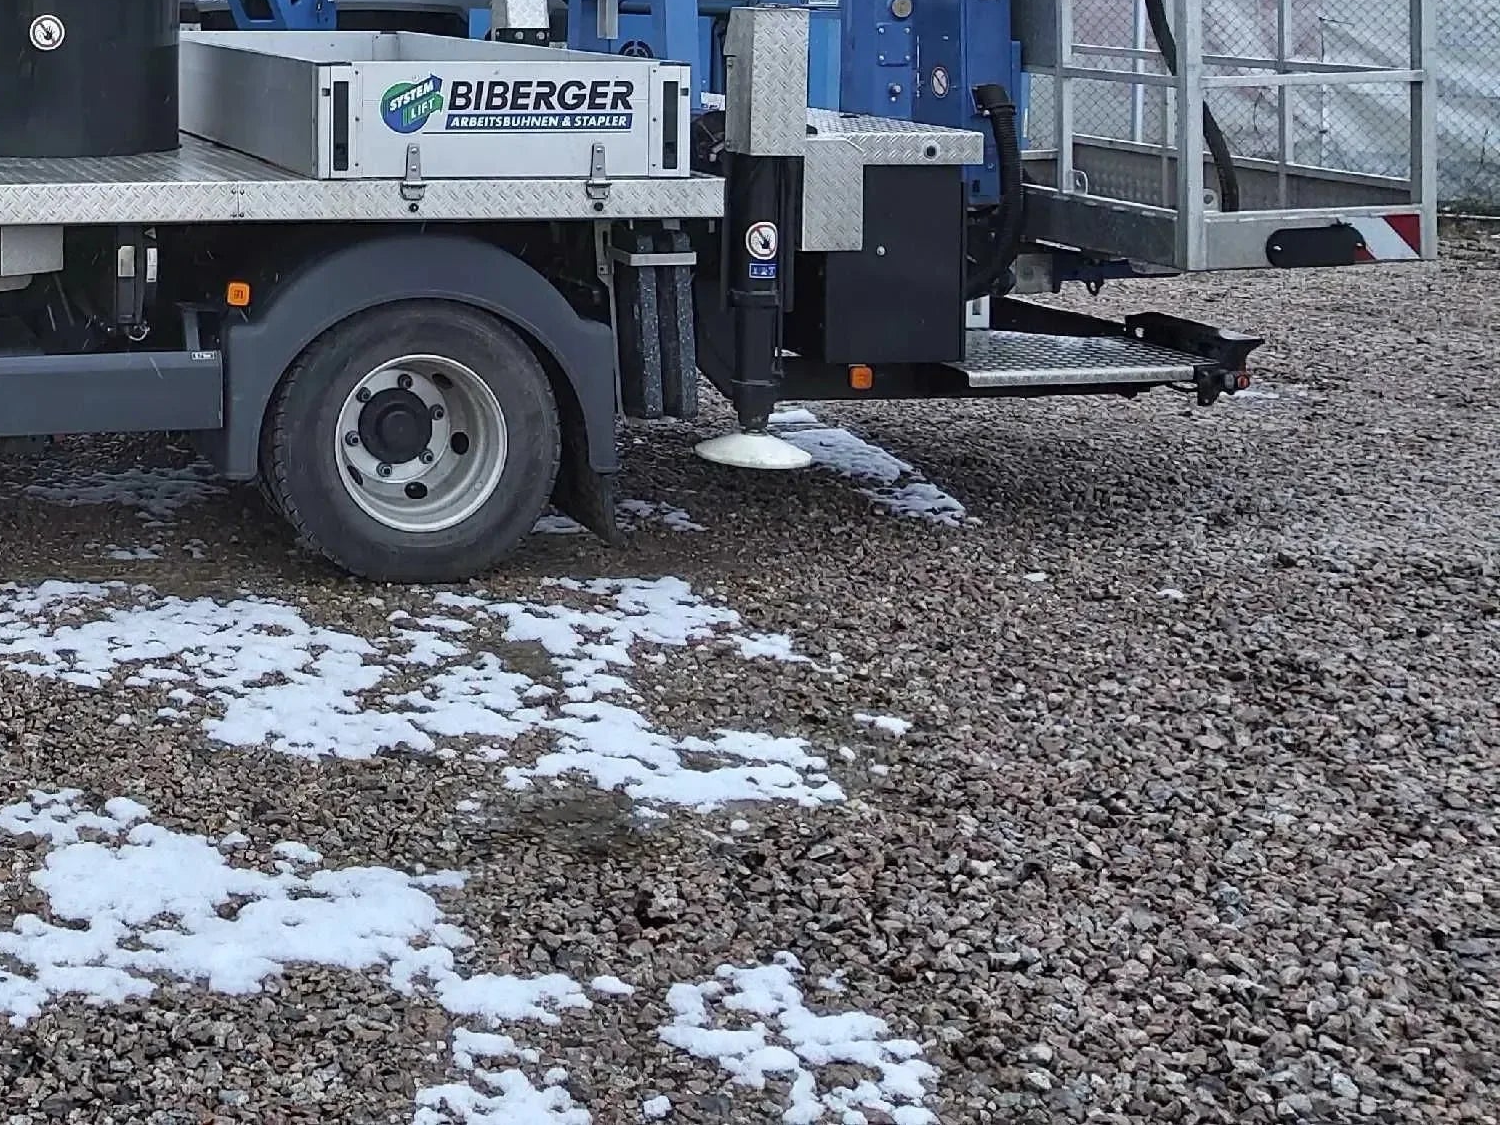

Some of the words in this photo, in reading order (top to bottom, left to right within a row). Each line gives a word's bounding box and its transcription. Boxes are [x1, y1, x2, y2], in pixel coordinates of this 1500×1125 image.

[389, 81, 435, 112] SYSTEM
[411, 97, 437, 119] LIFT
[449, 80, 634, 111] BIBERGER
[561, 115, 571, 127] &
[574, 115, 627, 127] STAPLER
